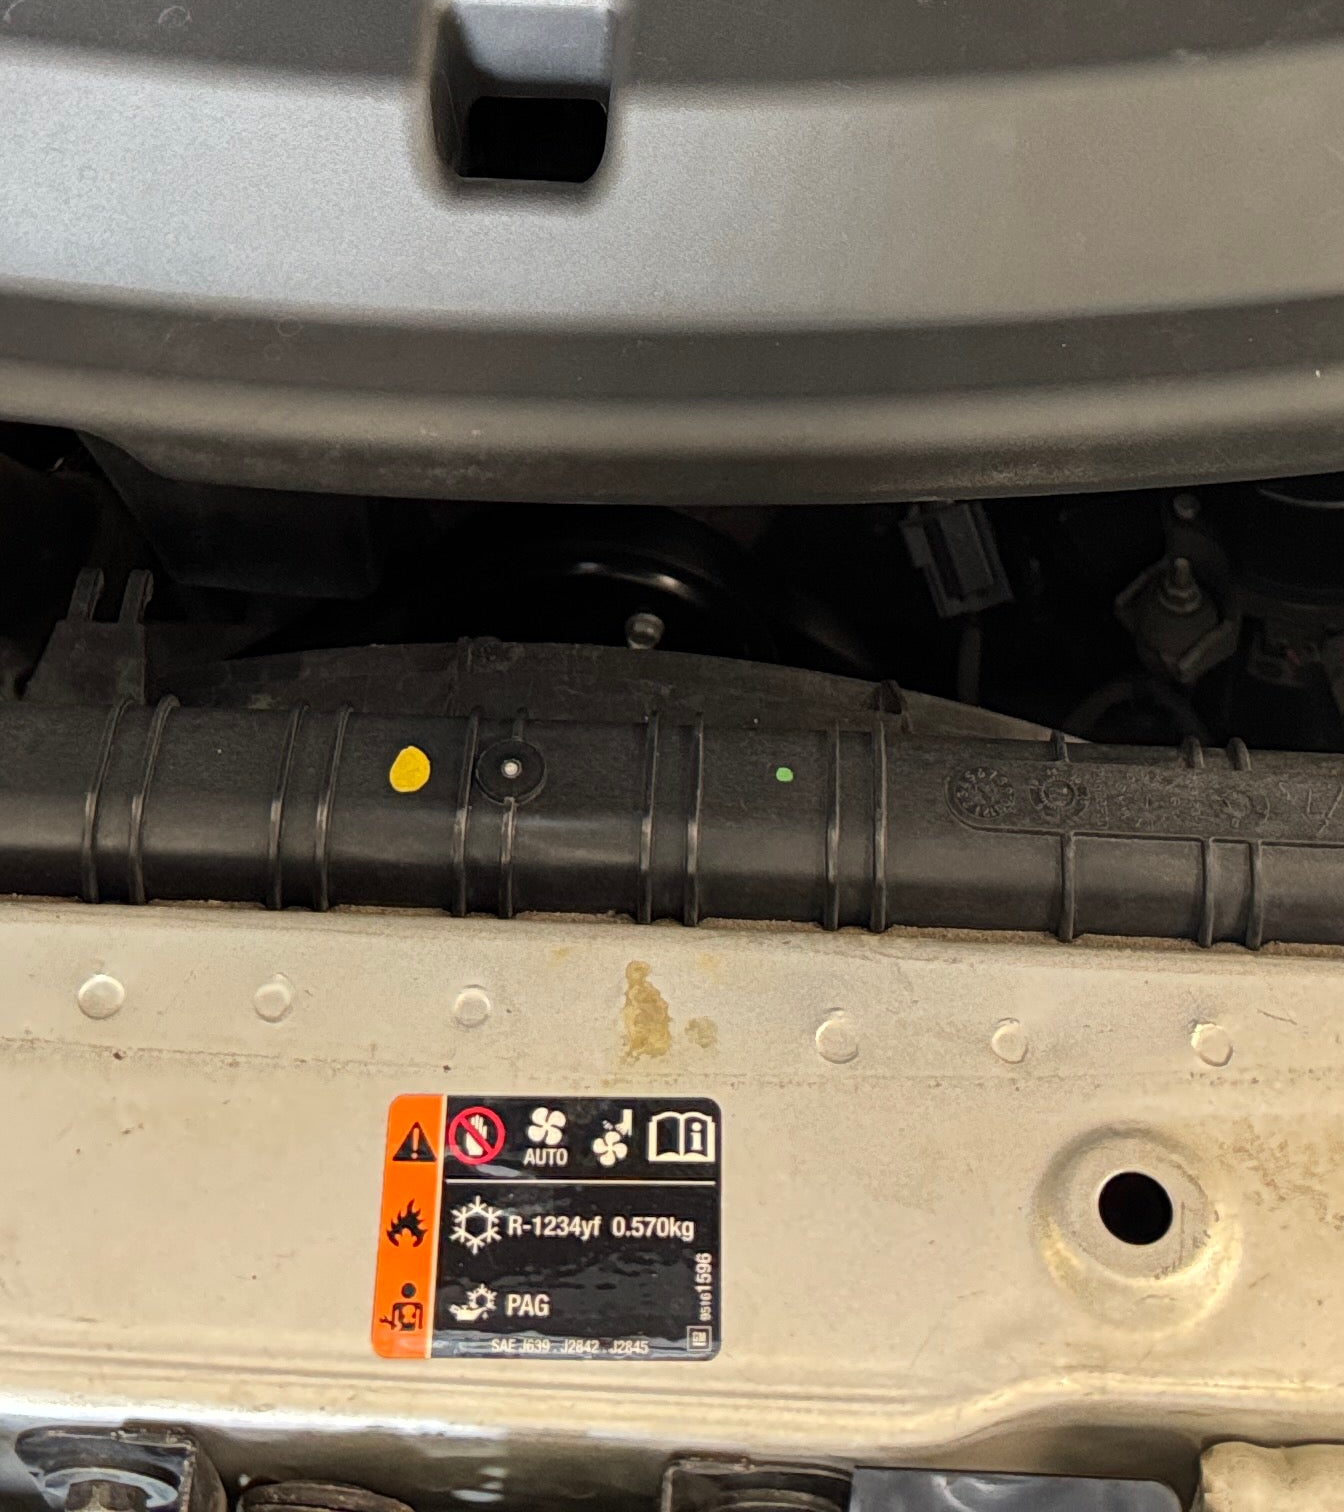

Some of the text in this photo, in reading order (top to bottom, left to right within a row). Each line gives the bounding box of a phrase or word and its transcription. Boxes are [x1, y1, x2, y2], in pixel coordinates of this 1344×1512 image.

[523, 1148, 569, 1167] AUTO
[507, 1216, 696, 1243] R-1234yf 0.570kg
[506, 1294, 551, 1317] PAG
